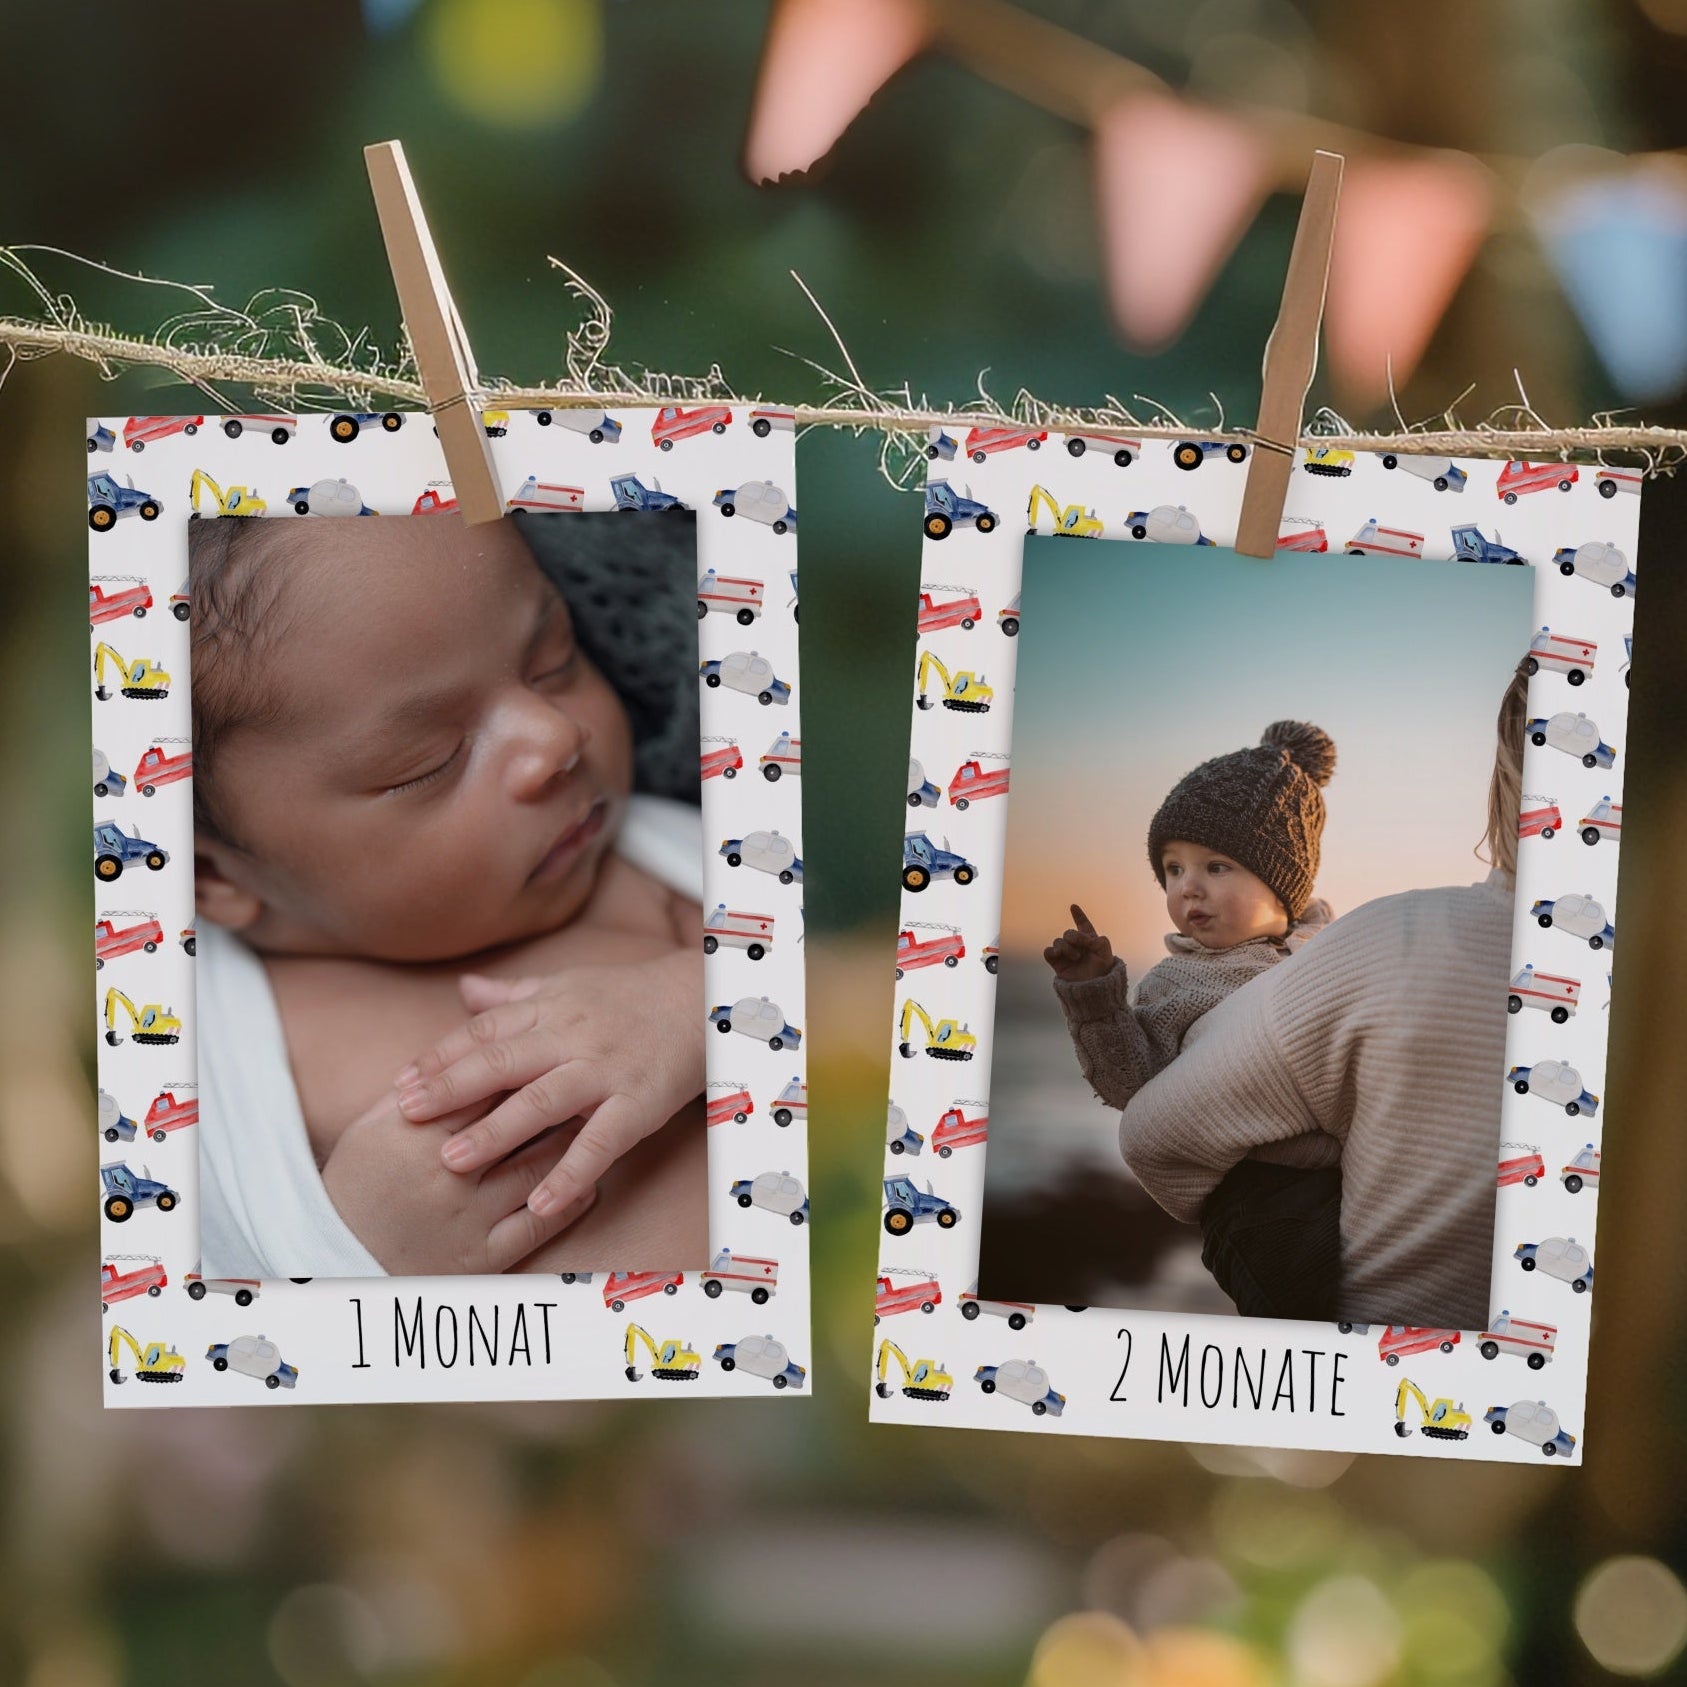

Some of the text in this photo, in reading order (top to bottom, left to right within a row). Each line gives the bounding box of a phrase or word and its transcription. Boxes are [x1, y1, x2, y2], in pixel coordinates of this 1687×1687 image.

[349, 1296, 558, 1370] 1 MONAT
[1109, 1328, 1349, 1417] 2 MONATE
